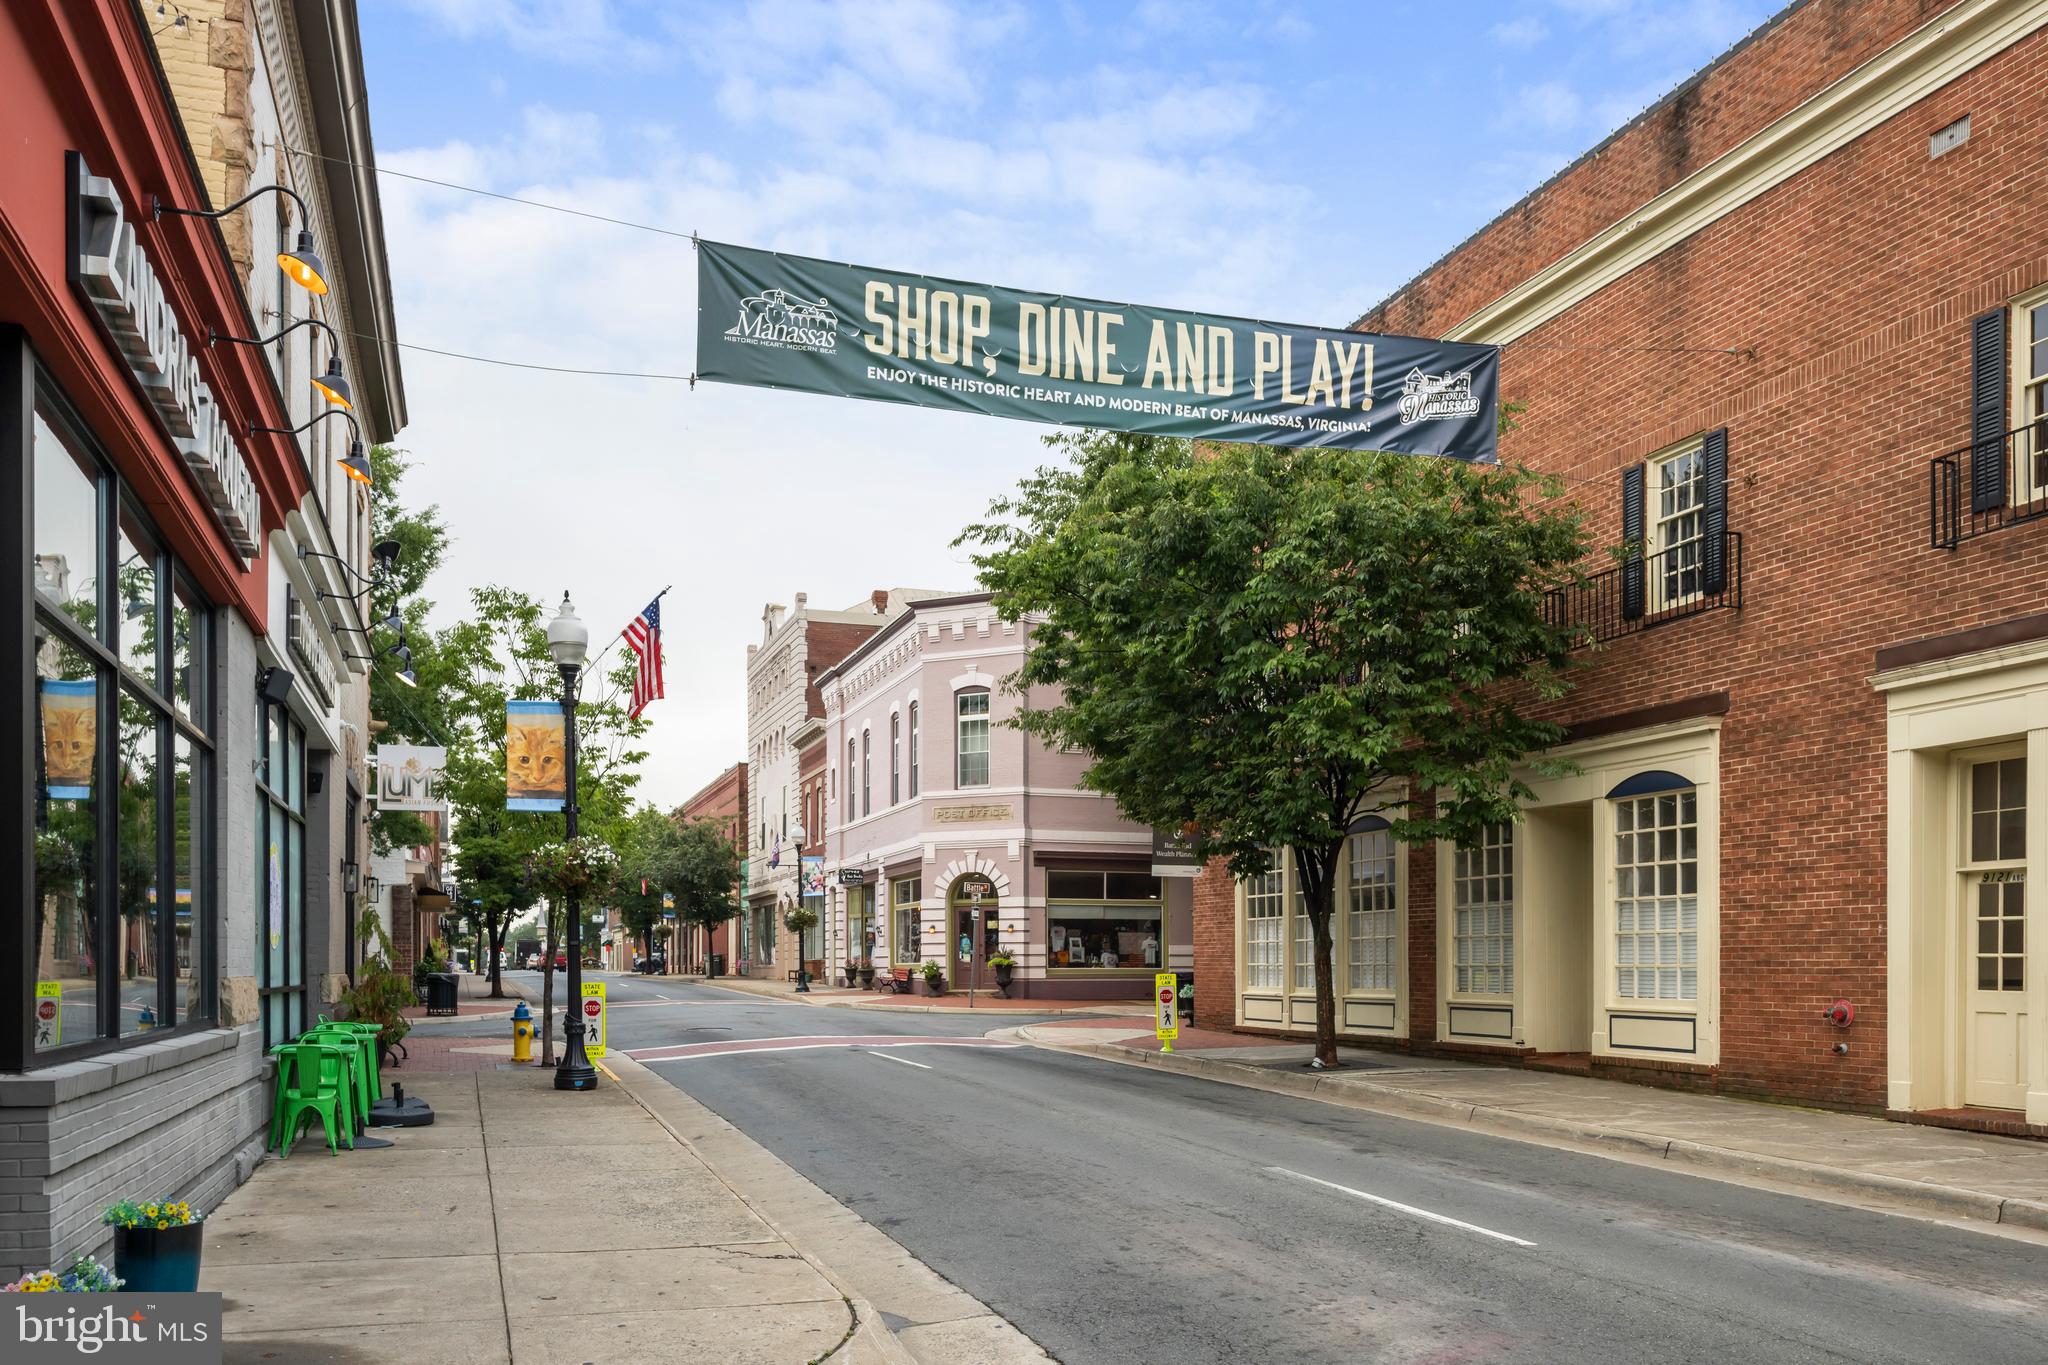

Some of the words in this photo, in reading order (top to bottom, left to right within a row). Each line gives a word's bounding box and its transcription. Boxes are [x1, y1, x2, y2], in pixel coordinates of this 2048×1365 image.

[724, 310, 837, 348] Manassas
[724, 335, 758, 345] HISTORIC
[760, 340, 785, 349] HEART.
[786, 344, 818, 353] MODERN
[864, 280, 996, 378] SHOP,
[1018, 302, 1124, 385] DINE
[1142, 319, 1234, 397] AND
[1254, 331, 1374, 412] PLAY!
[867, 366, 916, 384] ENJOY
[919, 373, 948, 389] THE
[951, 377, 1020, 399] HISTORIC
[1024, 387, 1072, 404] HEART
[1074, 394, 1105, 408] AND
[1109, 397, 1172, 416] MODERN
[1175, 405, 1207, 420] BEAT
[1210, 408, 1229, 421] OF
[1231, 411, 1305, 431] MANASSAS,
[1308, 417, 1371, 433] VIRGINIA!
[1400, 393, 1477, 422] Manassas
[1429, 392, 1467, 402] HISTORIC
[199, 381, 261, 558] TAQUERIA
[937, 810, 966, 820] POST
[968, 808, 1009, 818] OFFICE
[1982, 872, 2010, 882] 9121
